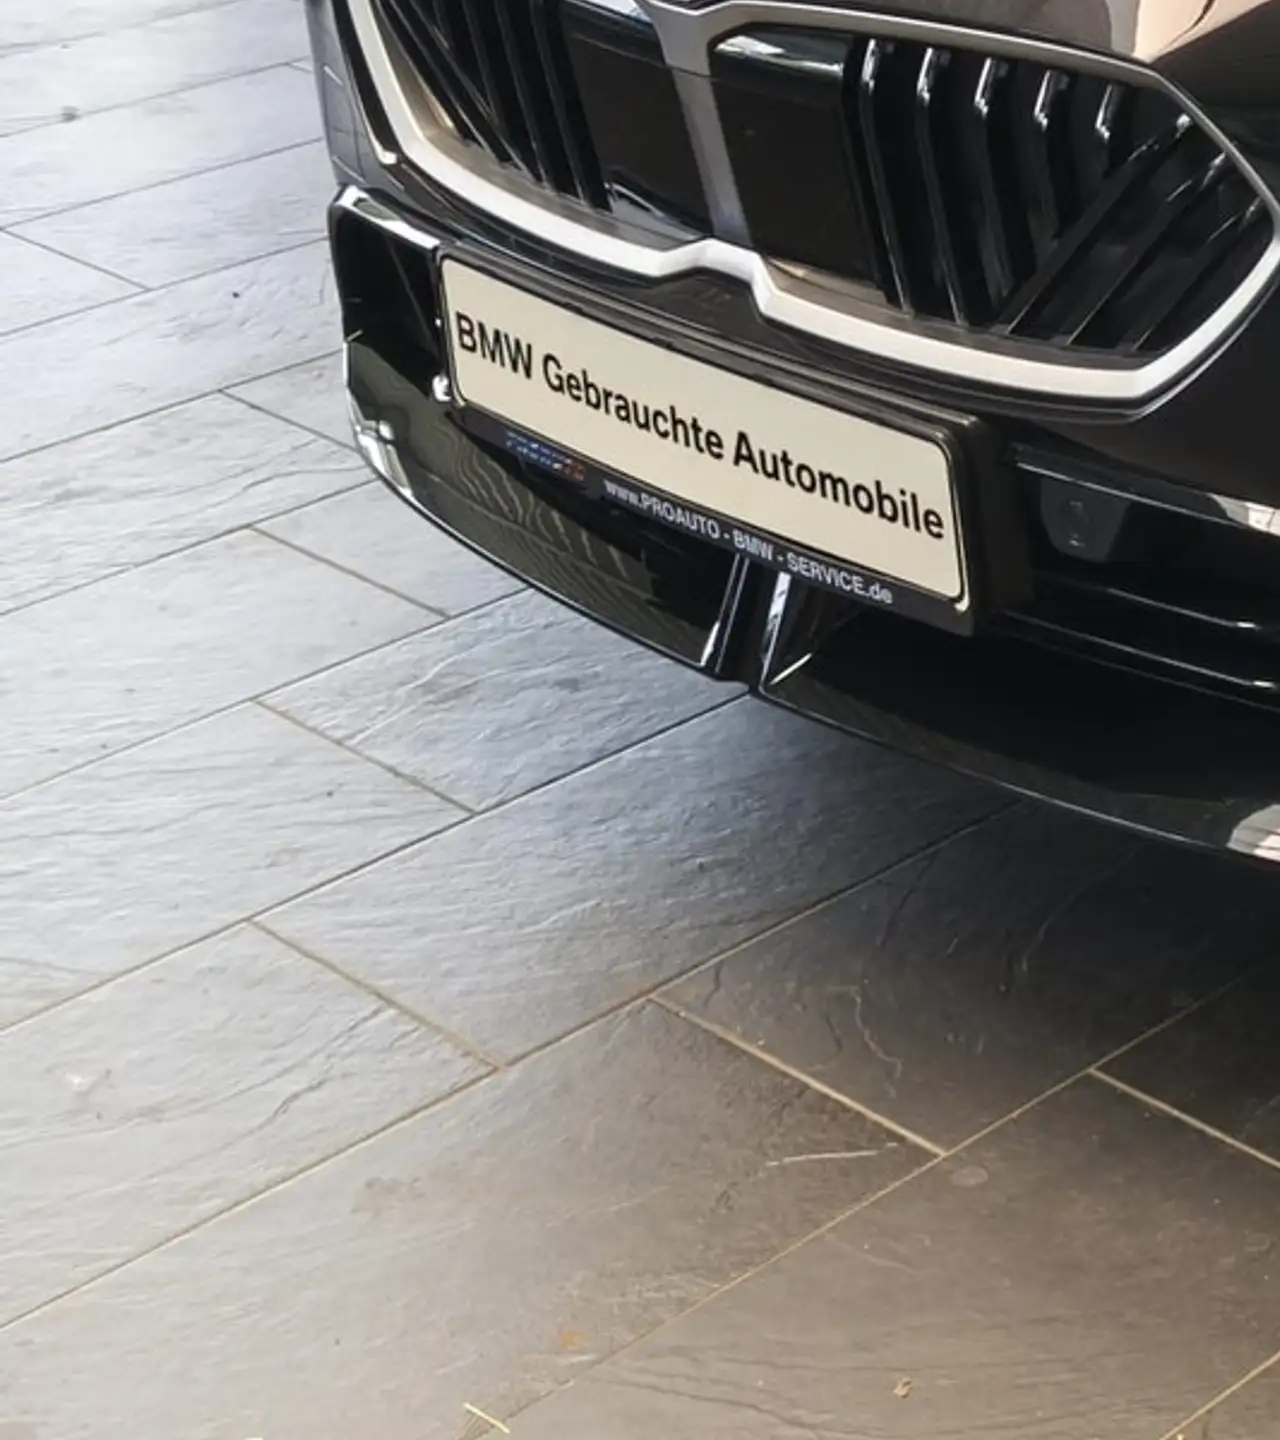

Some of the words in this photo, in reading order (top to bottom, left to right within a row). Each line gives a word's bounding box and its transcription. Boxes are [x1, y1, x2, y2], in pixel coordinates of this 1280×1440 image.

[455, 311, 532, 379] BMW
[542, 353, 724, 459] Gebrauchte
[733, 430, 944, 539] Automobile
[732, 529, 774, 561] BMW
[786, 551, 893, 604] SERVICE.de
